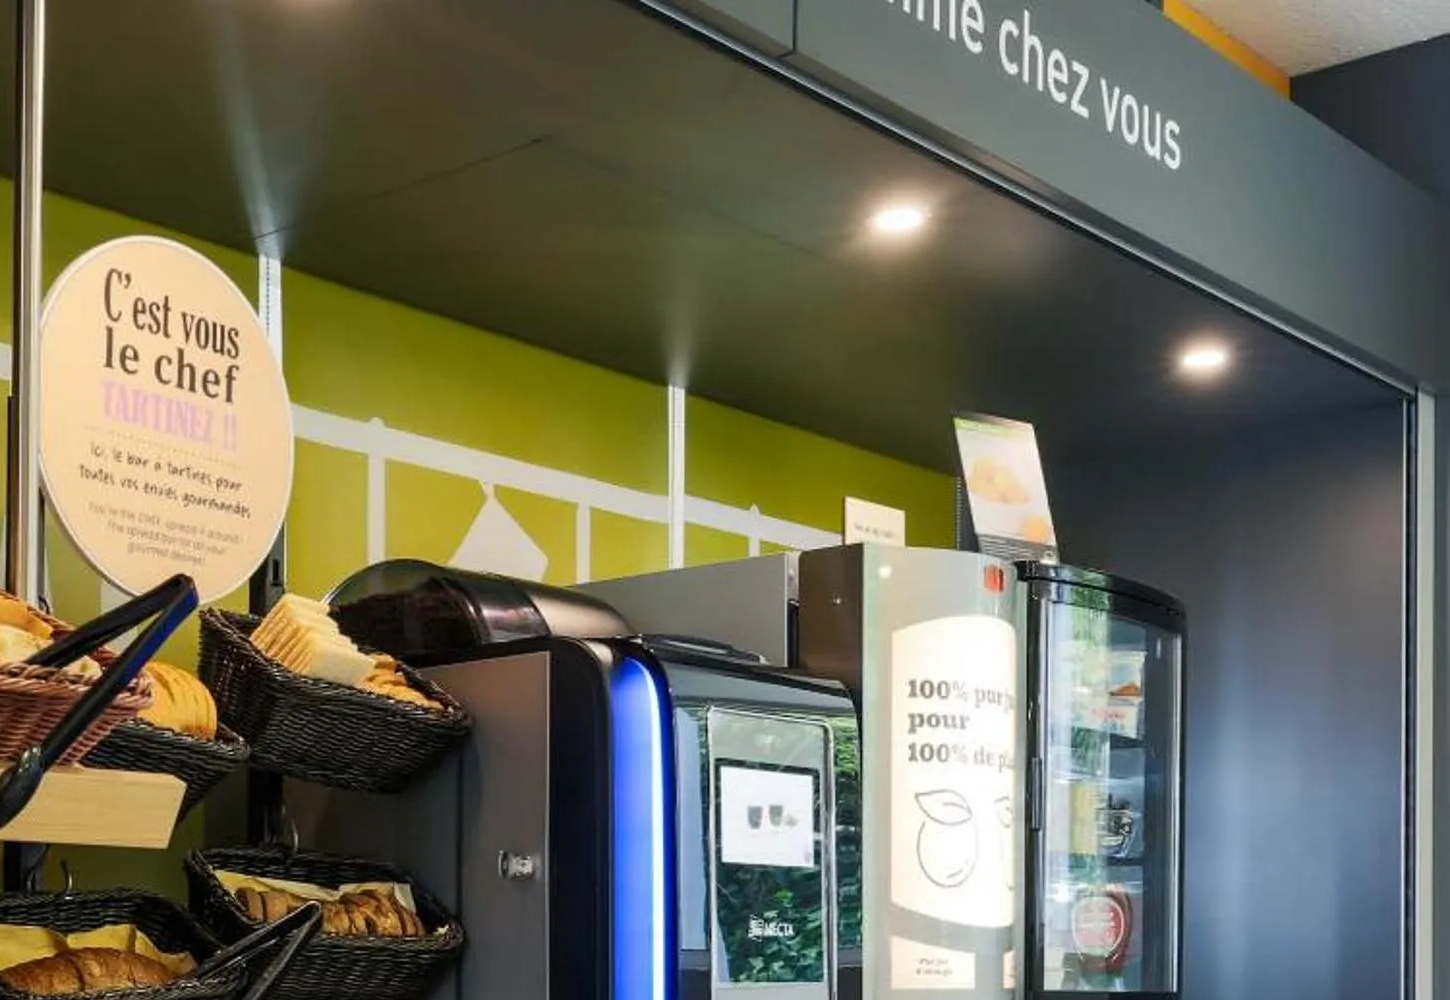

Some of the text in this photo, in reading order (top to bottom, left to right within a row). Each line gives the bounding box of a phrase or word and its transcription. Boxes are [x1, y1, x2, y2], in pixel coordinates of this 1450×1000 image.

[999, 9, 1090, 119] chez
[1100, 77, 1182, 170] vous
[103, 267, 240, 359] C'est vous
[103, 325, 240, 404] le chef
[102, 379, 214, 445] TARTINEZ
[126, 451, 149, 468] bar
[119, 477, 139, 491] vos
[907, 678, 969, 702] 100%
[907, 711, 970, 735] pour
[907, 741, 968, 765] 100%
